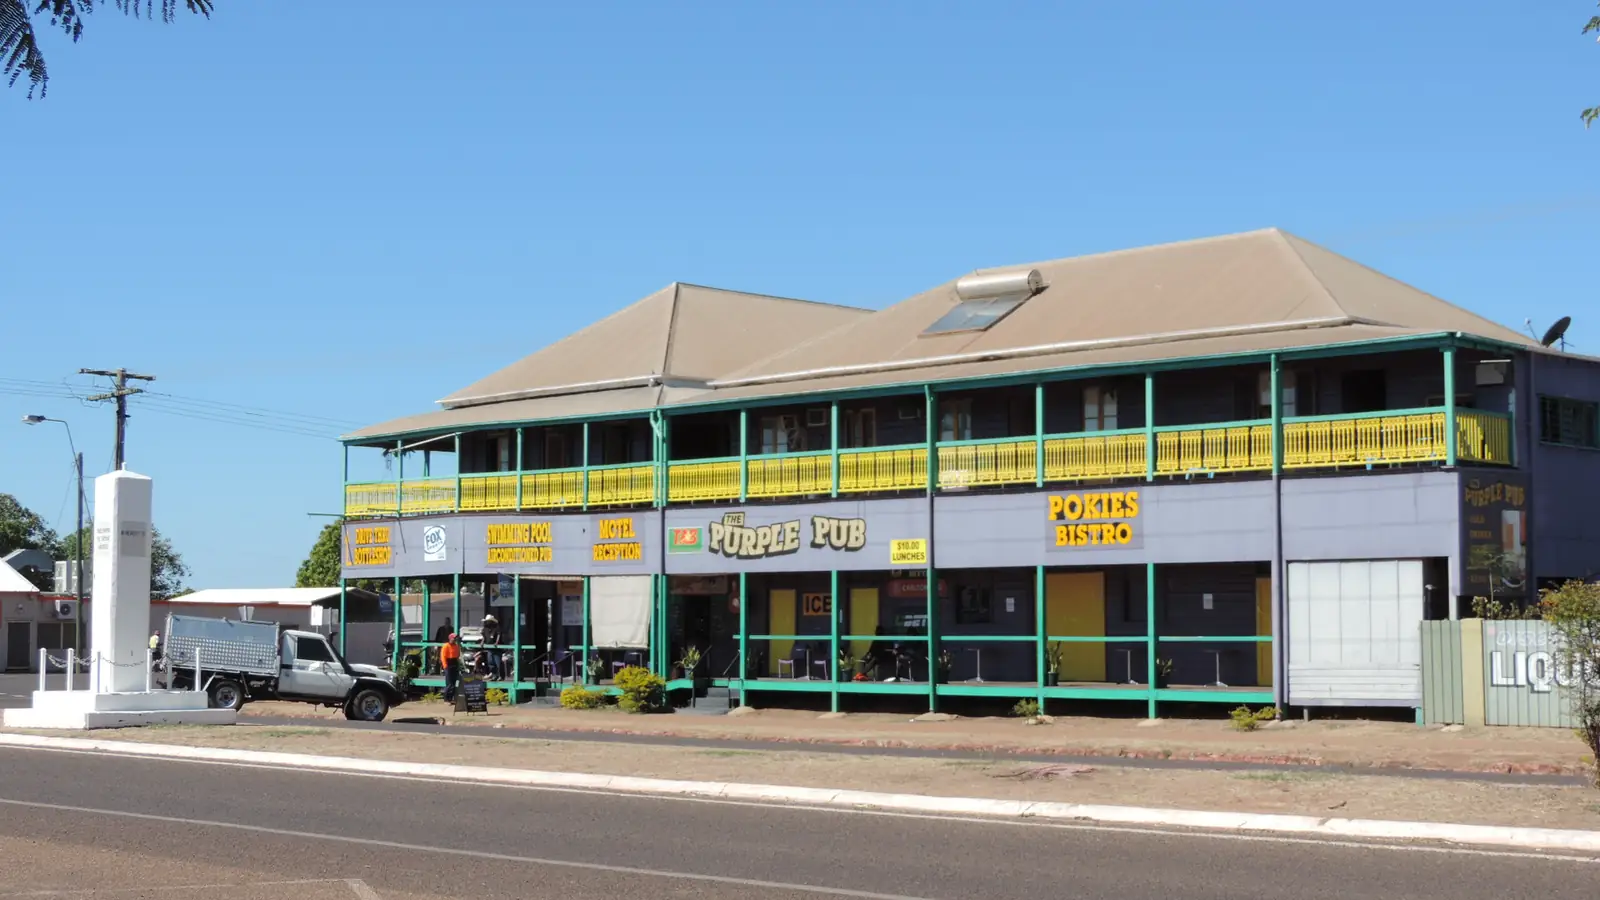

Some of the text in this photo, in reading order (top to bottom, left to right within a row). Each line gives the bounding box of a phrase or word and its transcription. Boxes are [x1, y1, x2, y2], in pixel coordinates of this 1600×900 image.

[1048, 490, 1139, 520] POKIES
[1505, 484, 1525, 507] PUB
[599, 517, 635, 539] MOTEL
[725, 514, 742, 524] THE
[425, 529, 442, 547] FOX
[487, 522, 552, 545] SWIMMING POOL
[709, 516, 866, 559] PURPLE PUB
[1055, 522, 1132, 546] BISTRO
[592, 542, 641, 561] RECEPTION
[897, 541, 919, 550] $10.00
[892, 552, 925, 561] LUNCHES
[805, 594, 832, 613] ICE
